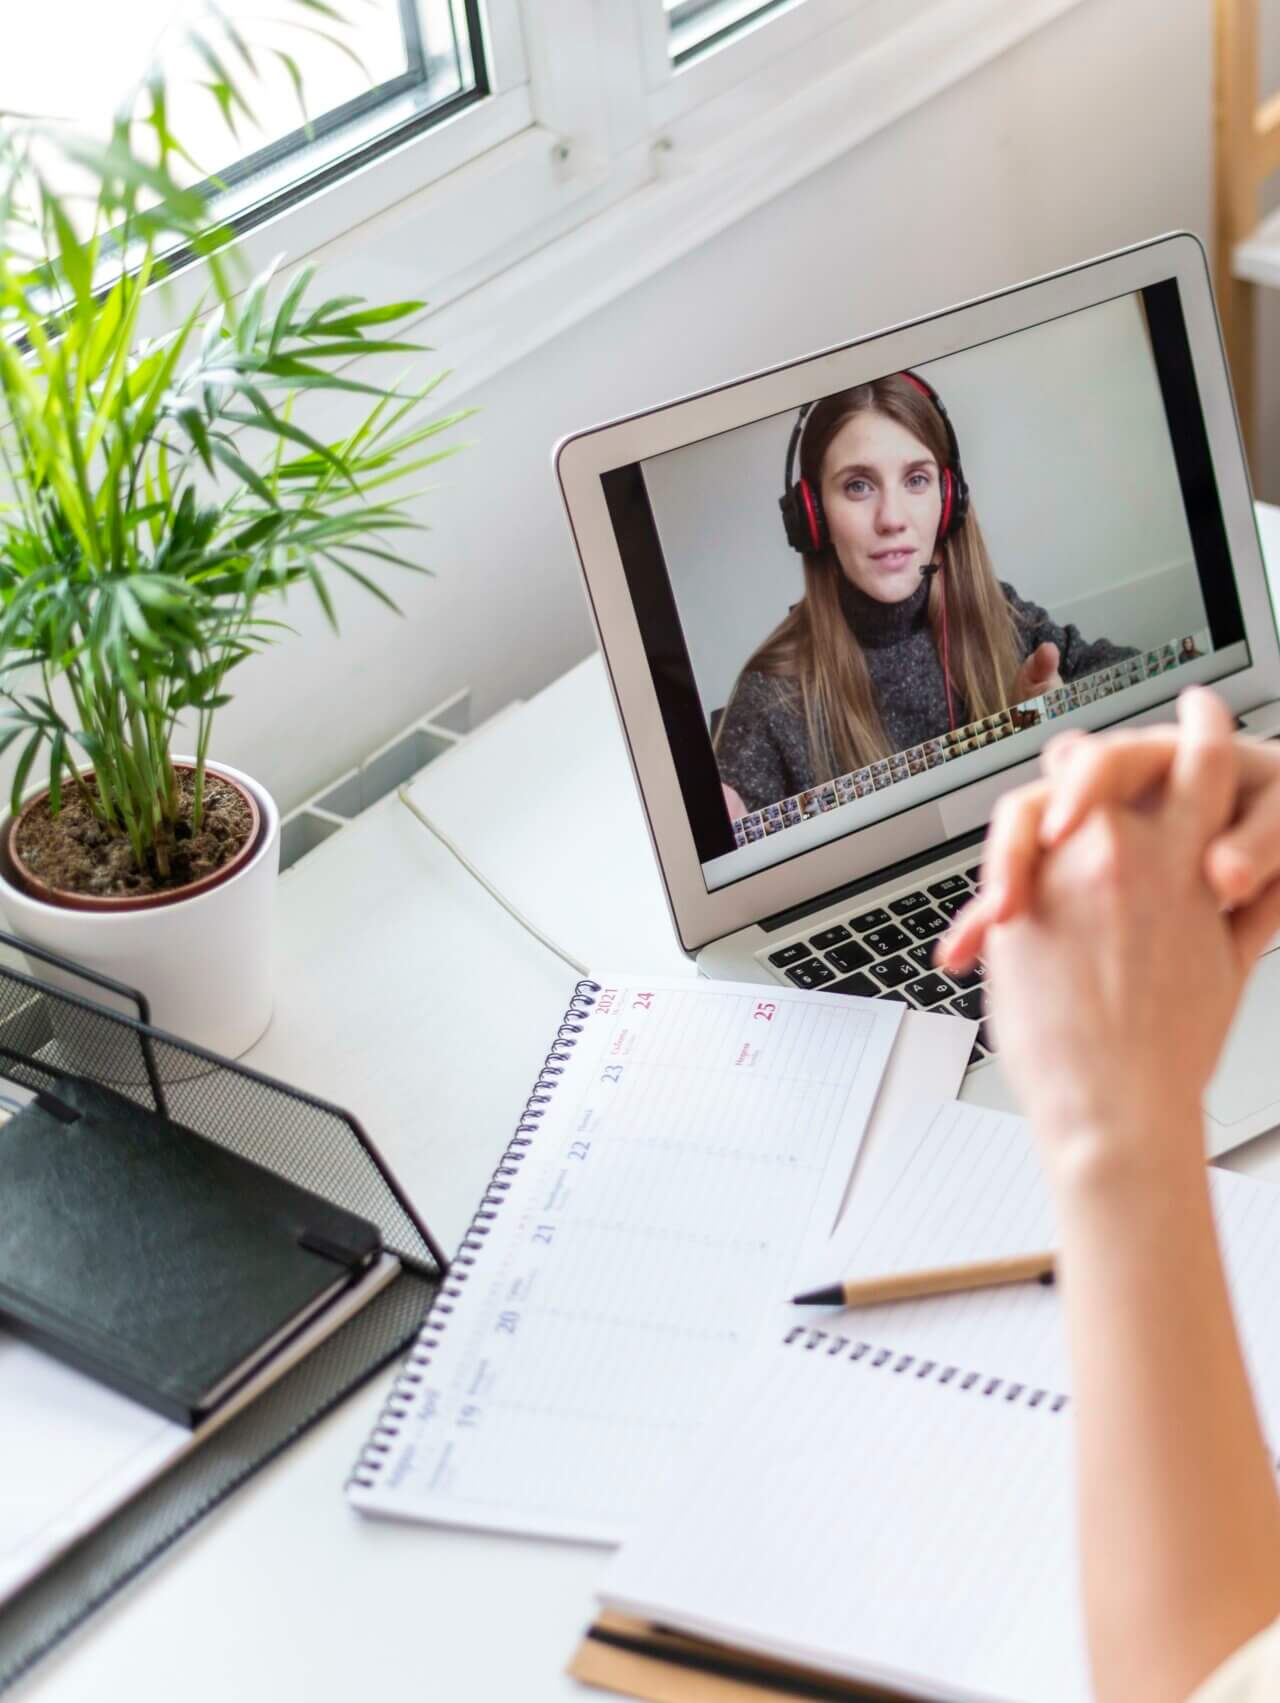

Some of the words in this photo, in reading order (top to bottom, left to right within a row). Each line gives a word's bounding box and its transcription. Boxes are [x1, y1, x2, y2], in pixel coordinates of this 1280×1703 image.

[878, 942, 889, 950] 2
[913, 947, 928, 957] W
[913, 984, 924, 992] A
[595, 988, 618, 1014] 2021
[632, 992, 656, 1009] 24
[753, 1003, 776, 1021] 25
[600, 1064, 623, 1083] 23
[567, 1141, 591, 1160] 22
[531, 1225, 556, 1244] 21
[494, 1310, 520, 1334] 20
[455, 1404, 480, 1428] 19
